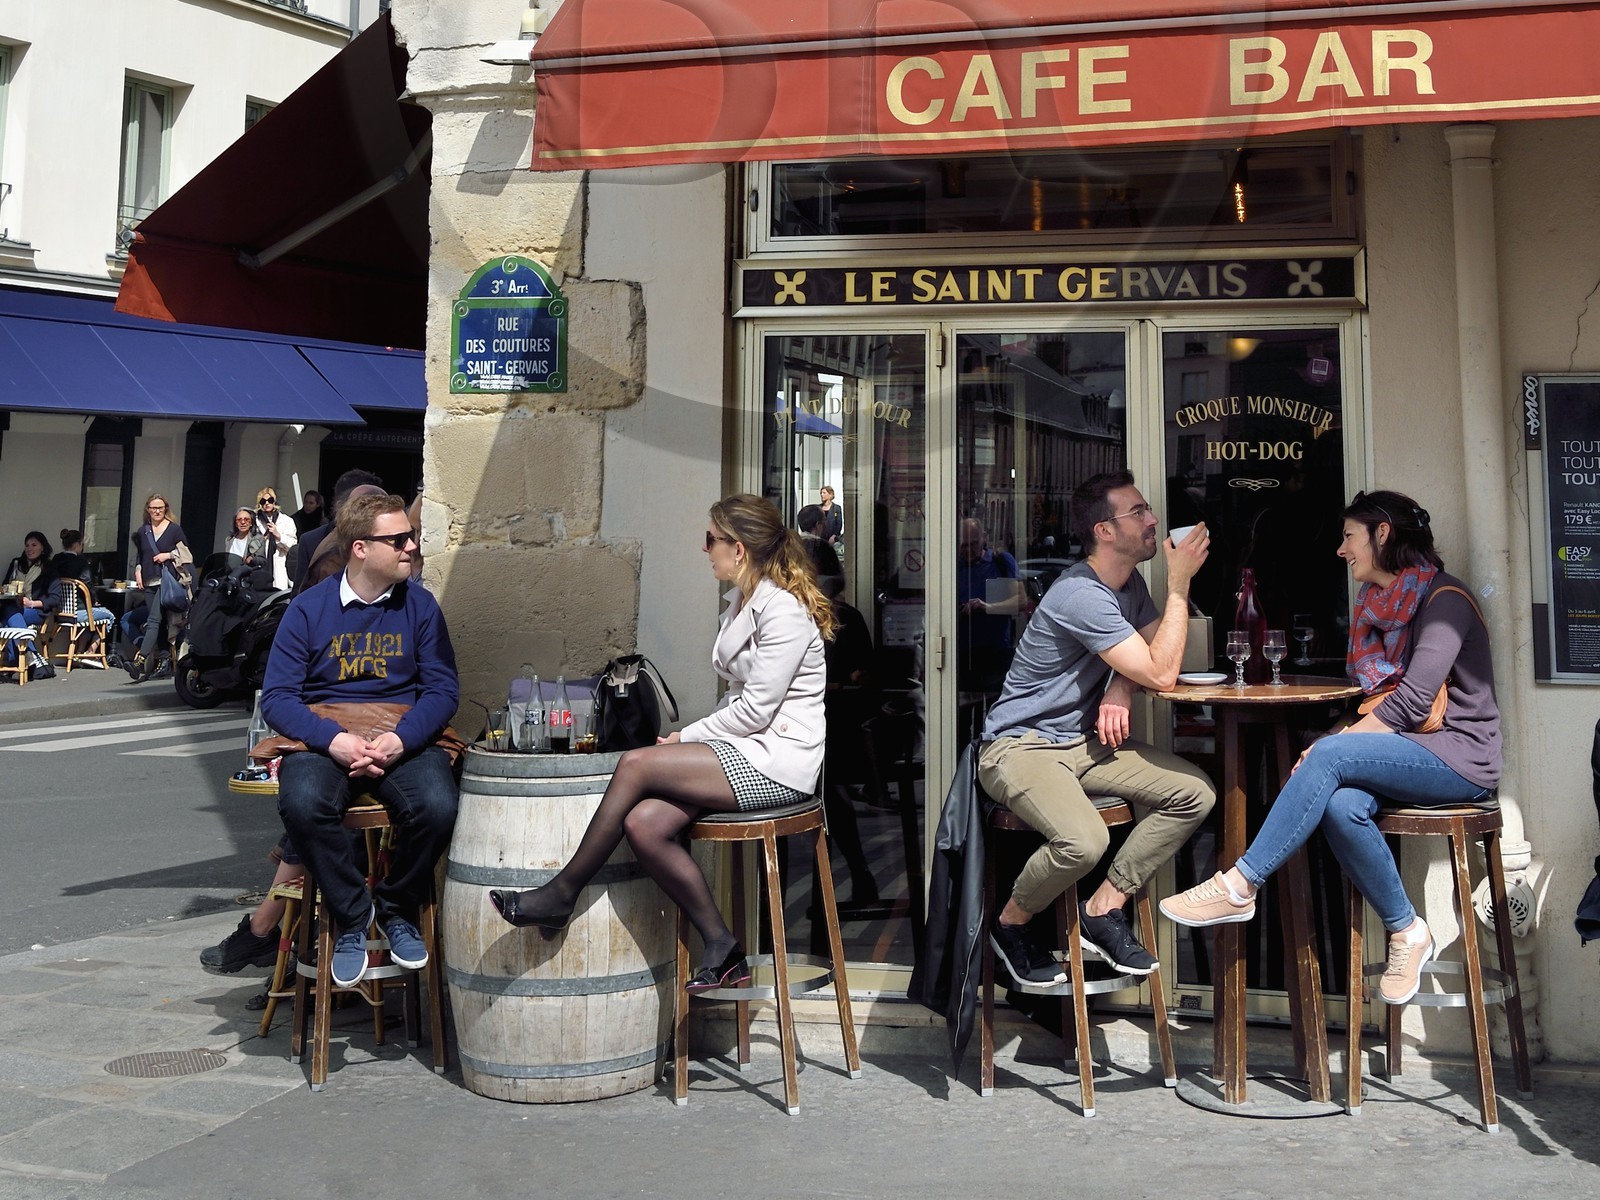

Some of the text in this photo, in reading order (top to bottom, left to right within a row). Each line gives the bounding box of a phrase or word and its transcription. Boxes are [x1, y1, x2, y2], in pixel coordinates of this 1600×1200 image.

[885, 29, 1436, 125] CAFE BAR
[844, 262, 1248, 303] LE SAINT GERVAIS
[497, 317, 520, 332] RUE
[465, 338, 551, 354] DES COUTURES
[830, 397, 857, 415] DU
[1175, 395, 1334, 431] CROQUE MONSIEUR
[1206, 441, 1304, 460] HOT-DOG
[1564, 514, 1584, 525] 179
[1585, 515, 1593, 525] €
